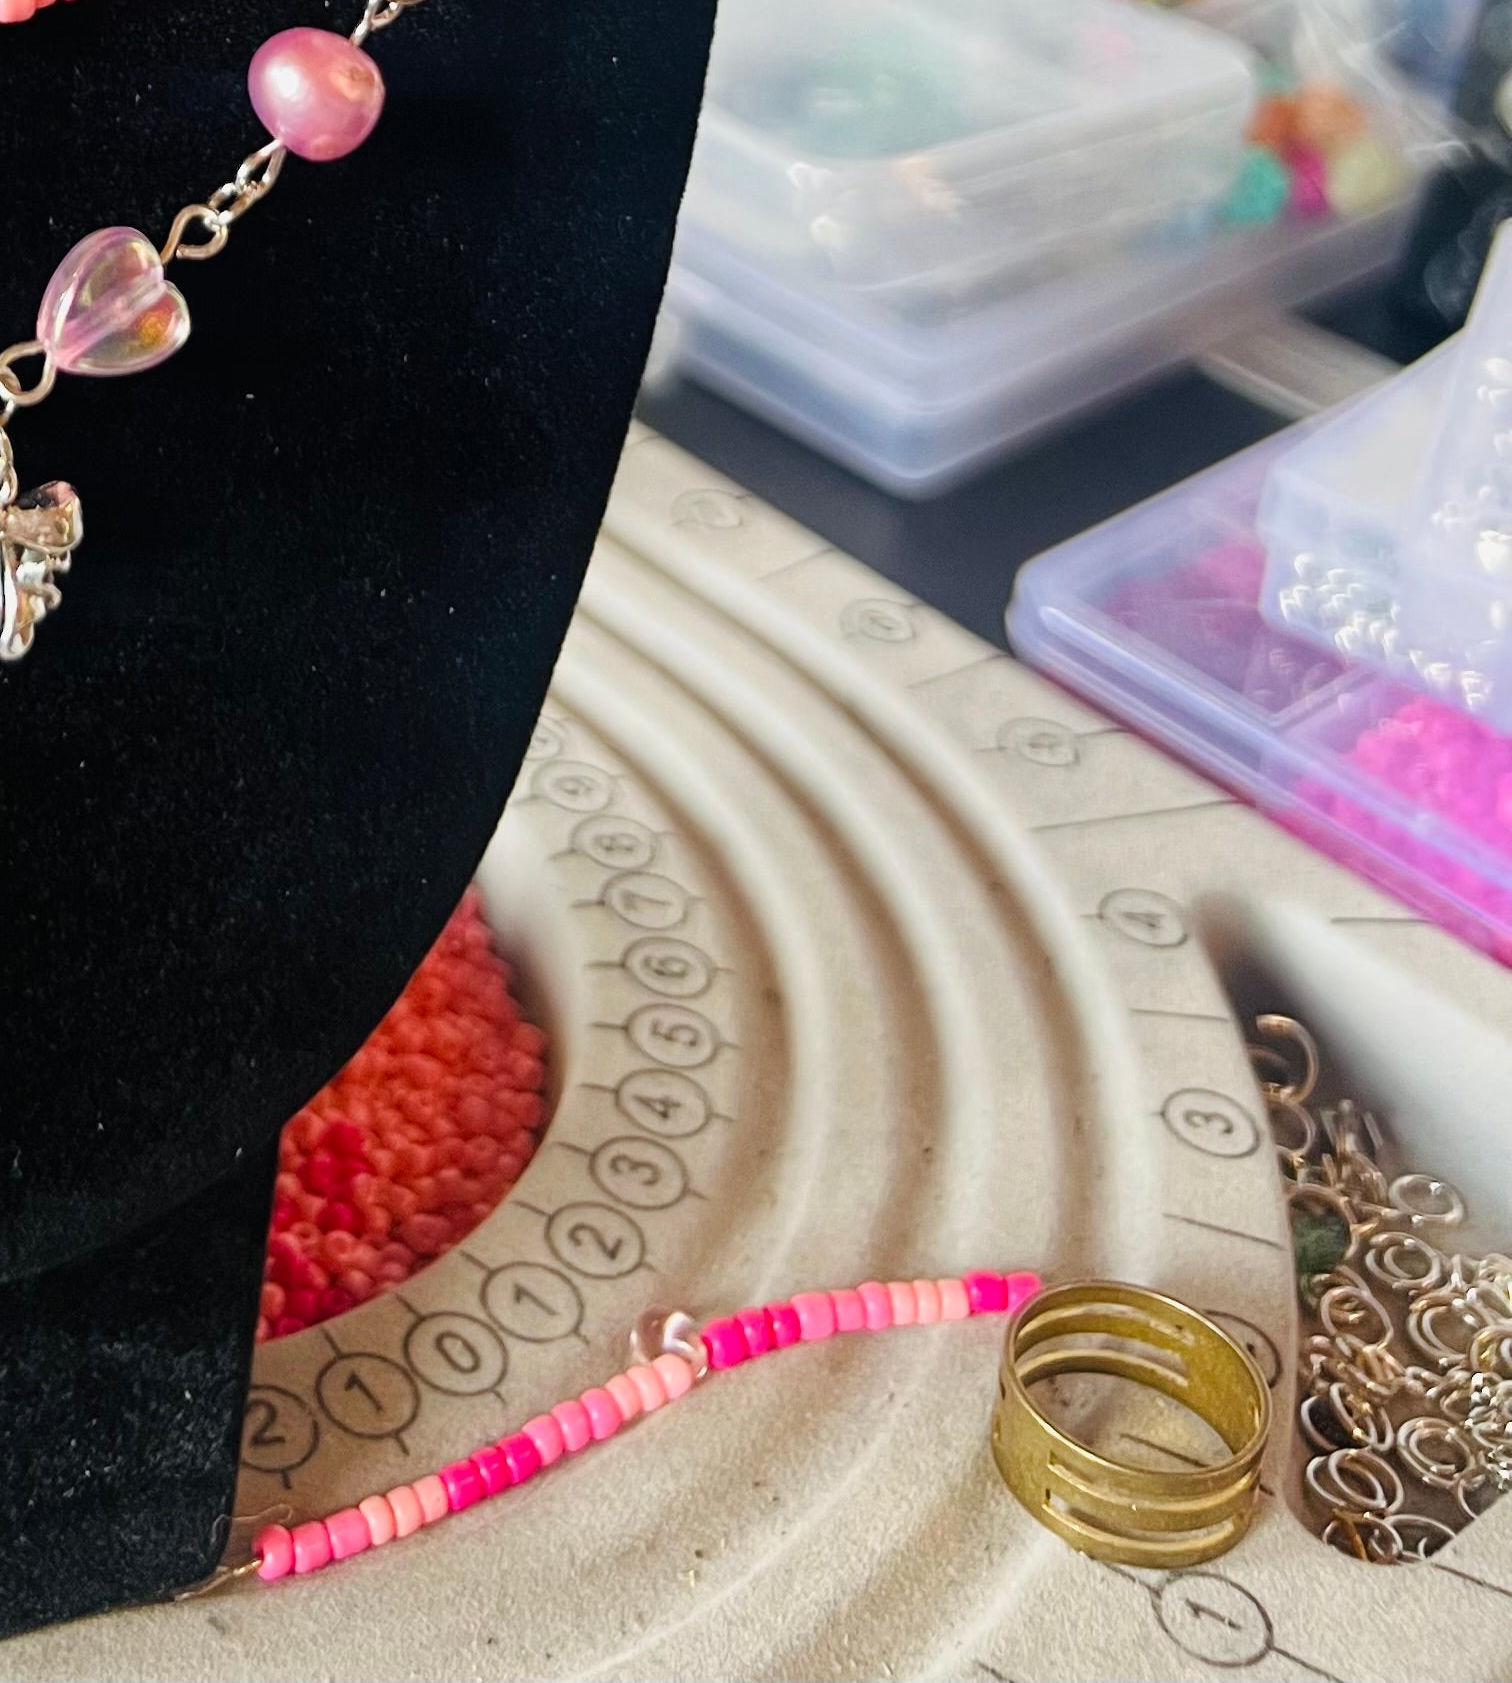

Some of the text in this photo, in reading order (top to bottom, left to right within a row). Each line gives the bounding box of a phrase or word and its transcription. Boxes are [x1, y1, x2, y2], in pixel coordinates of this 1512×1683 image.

[619, 887, 675, 913] 7
[642, 954, 692, 980] 6
[649, 1018, 701, 1048] 5
[631, 1093, 682, 1120] 4
[1185, 1109, 1235, 1135] 3
[608, 1152, 662, 1187] 3
[567, 1221, 624, 1261] 2
[512, 1281, 560, 1317] 1
[434, 1329, 482, 1374] 0
[344, 1370, 384, 1413] 1
[247, 1397, 286, 1448] 2
[1185, 1598, 1243, 1632] 1
